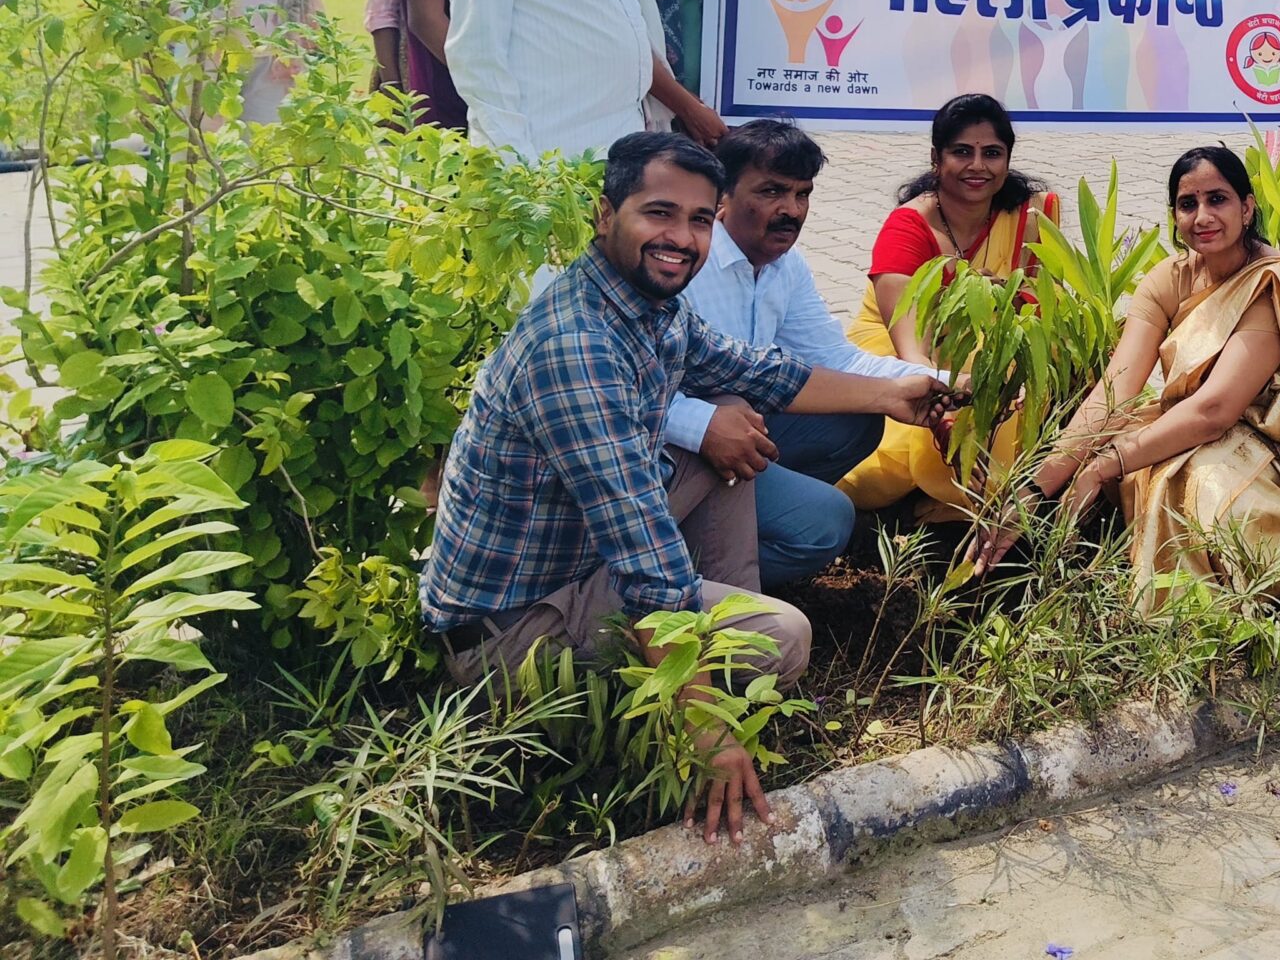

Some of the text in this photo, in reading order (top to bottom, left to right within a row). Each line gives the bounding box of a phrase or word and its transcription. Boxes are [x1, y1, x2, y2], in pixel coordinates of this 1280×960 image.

[757, 67, 869, 83] नए समाज की ओर
[747, 78, 878, 95] Towards a new dawn
